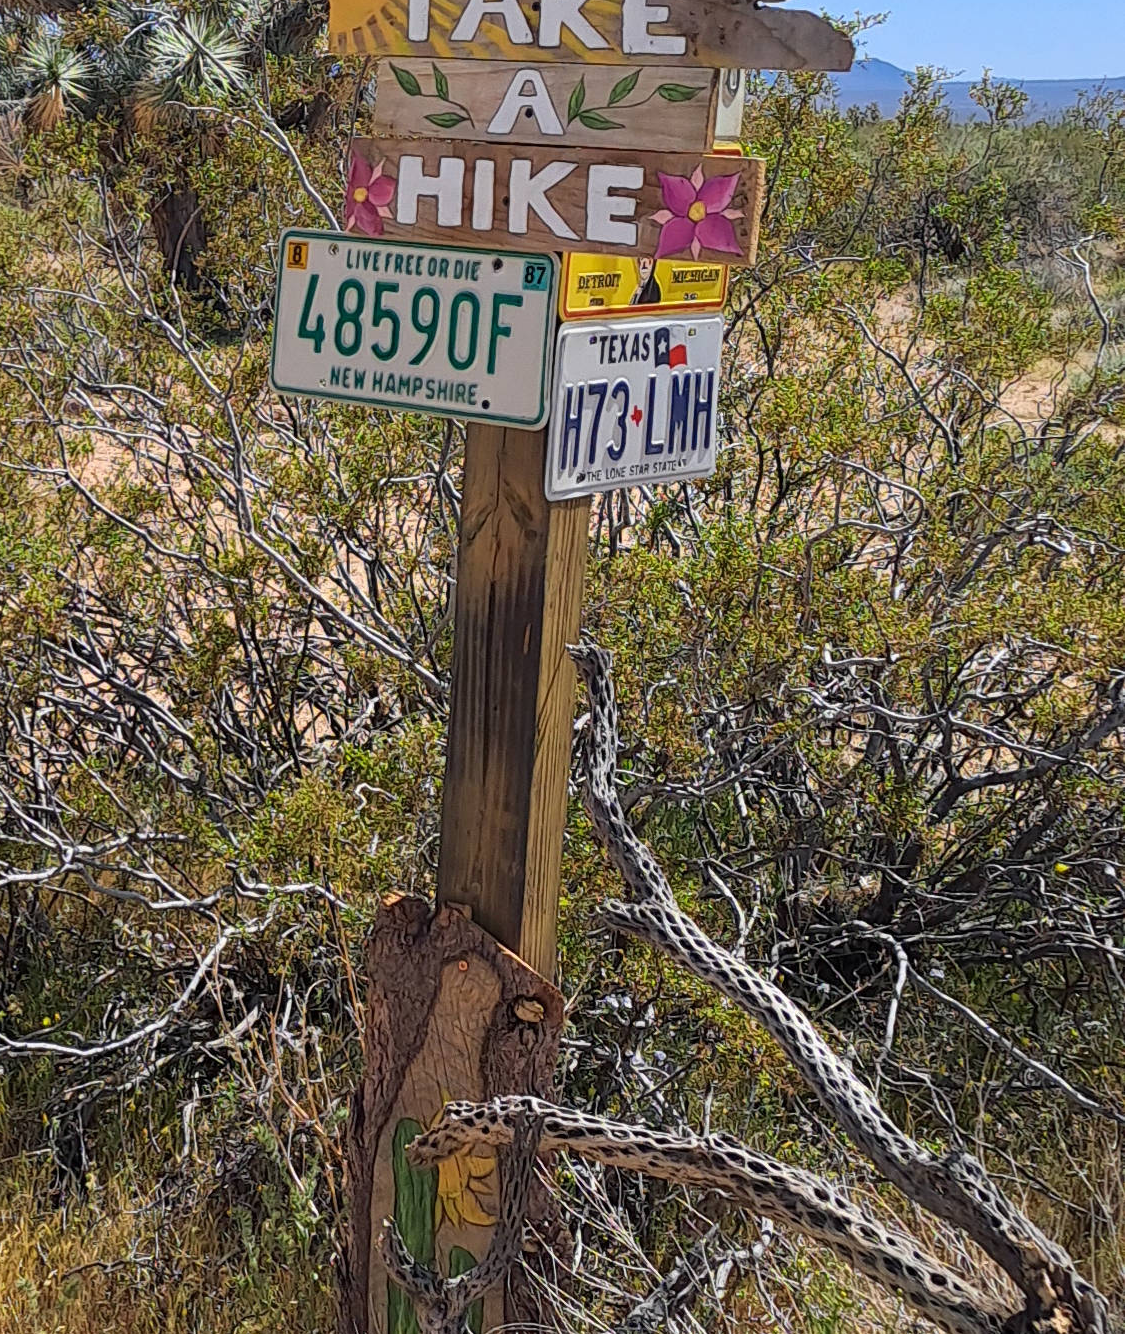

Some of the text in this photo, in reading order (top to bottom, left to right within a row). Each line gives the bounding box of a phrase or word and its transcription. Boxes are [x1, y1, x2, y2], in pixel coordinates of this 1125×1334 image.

[486, 68, 565, 136] A
[396, 155, 644, 246] HIKE
[292, 245, 302, 264] 8
[346, 249, 481, 281] LIVE FREE OR DIE
[524, 265, 547, 285] 87
[578, 273, 622, 291] DETROIT
[671, 267, 721, 284] MICHIGAN
[297, 274, 524, 375] 48590F
[598, 330, 651, 365] TEXAS
[329, 366, 479, 405] NEW HAMPSHIRE
[586, 460, 677, 483] THE LONE STAR STATE
